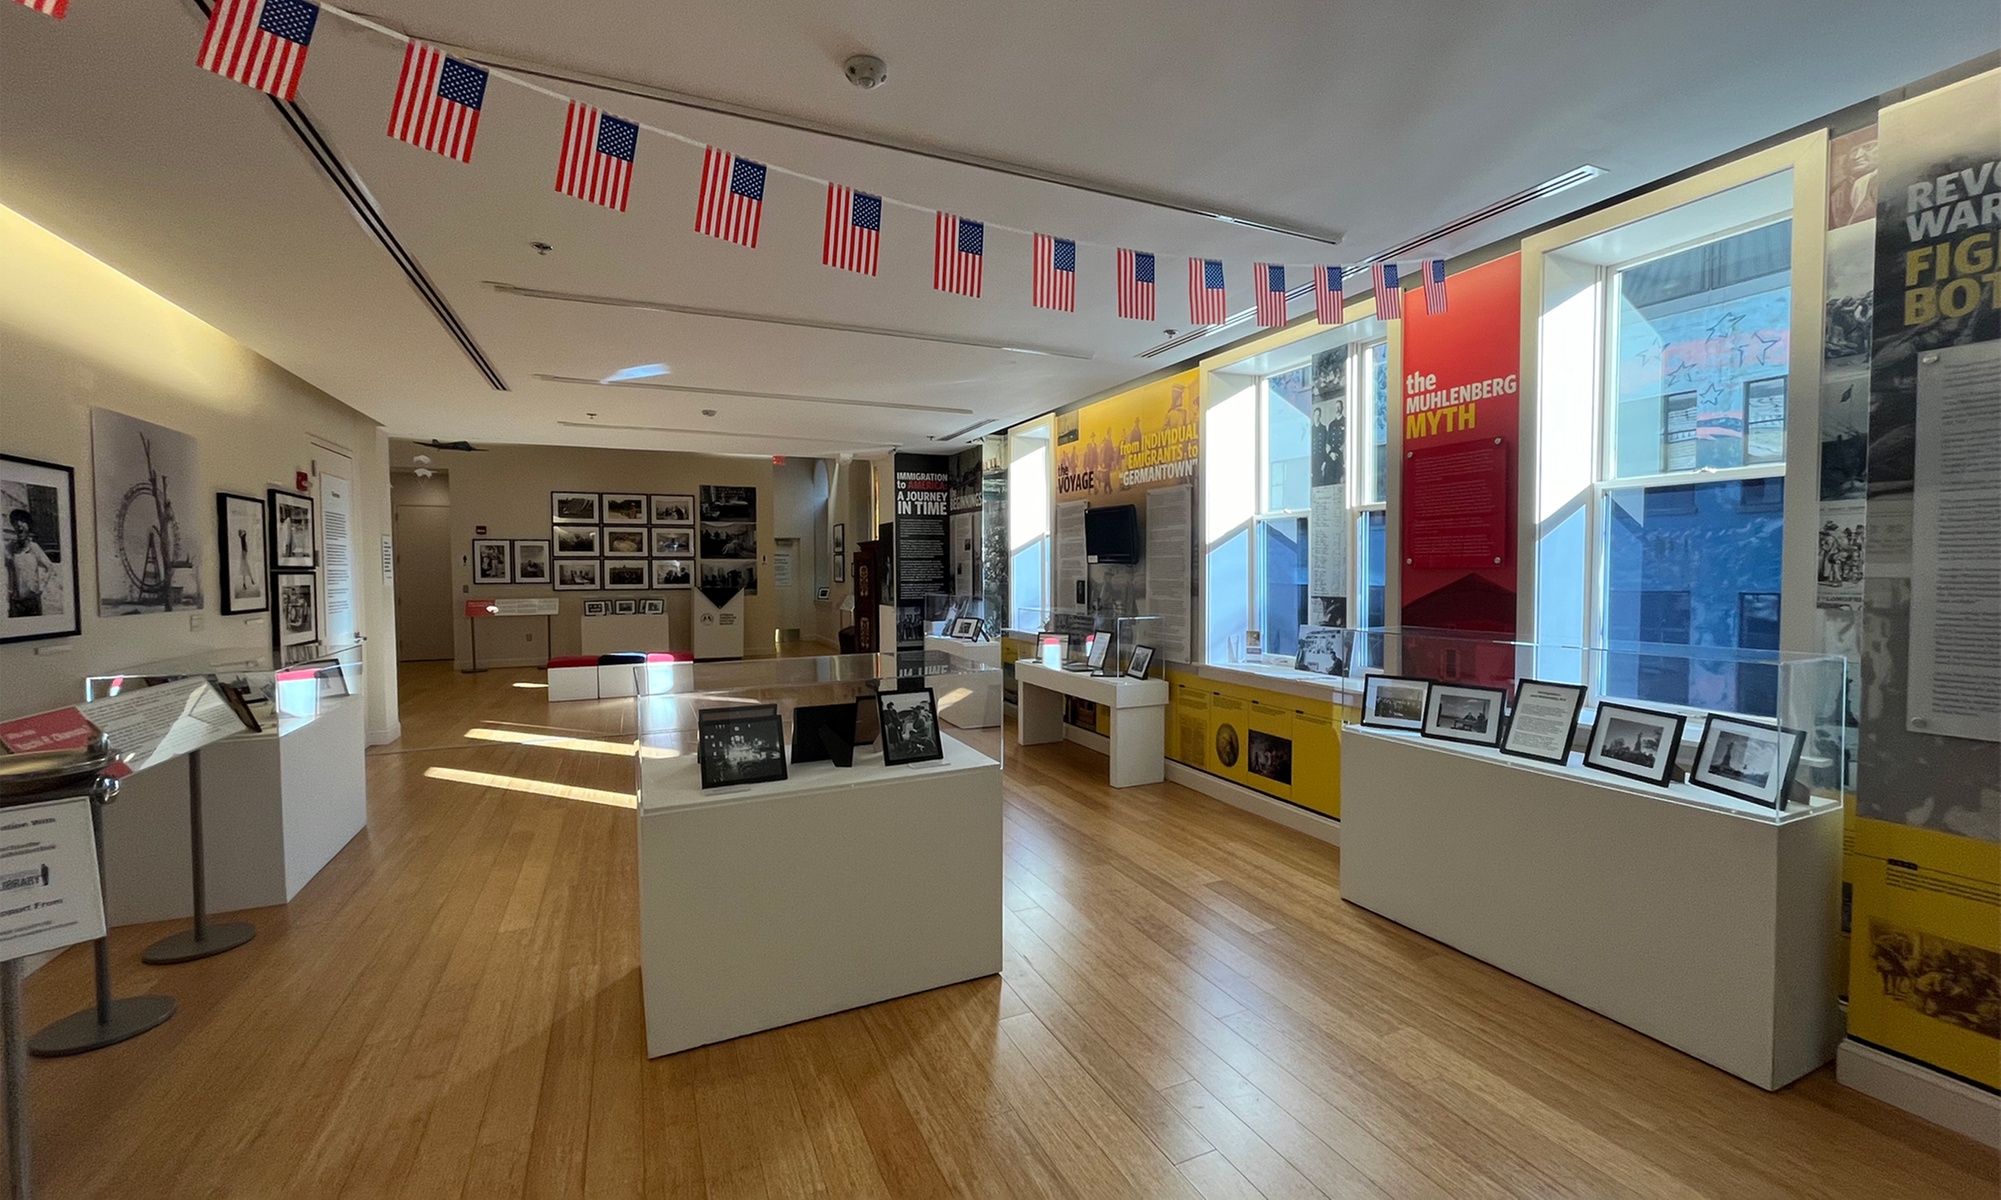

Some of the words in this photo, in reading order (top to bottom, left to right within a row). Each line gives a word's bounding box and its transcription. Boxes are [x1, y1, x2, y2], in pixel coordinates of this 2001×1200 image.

[1406, 370, 1437, 395] the
[1406, 374, 1517, 415] MUHLENBERG
[1405, 402, 1476, 440] MYTH
[1120, 441, 1139, 456] from
[1141, 424, 1198, 450] INDIVIDUAL
[1128, 444, 1184, 470] EMIGRANTS
[1187, 442, 1198, 459] to
[896, 472, 948, 482] IMMIGRATION
[1057, 463, 1069, 477] the
[896, 481, 906, 489] to
[907, 480, 948, 490] AMERICA:
[1057, 470, 1095, 494] VOYAGE
[897, 491, 905, 501] A
[906, 491, 948, 502] JOURNEY
[949, 492, 983, 511] BEGINNINGS
[897, 501, 912, 515] IN
[914, 501, 948, 516] TIME
